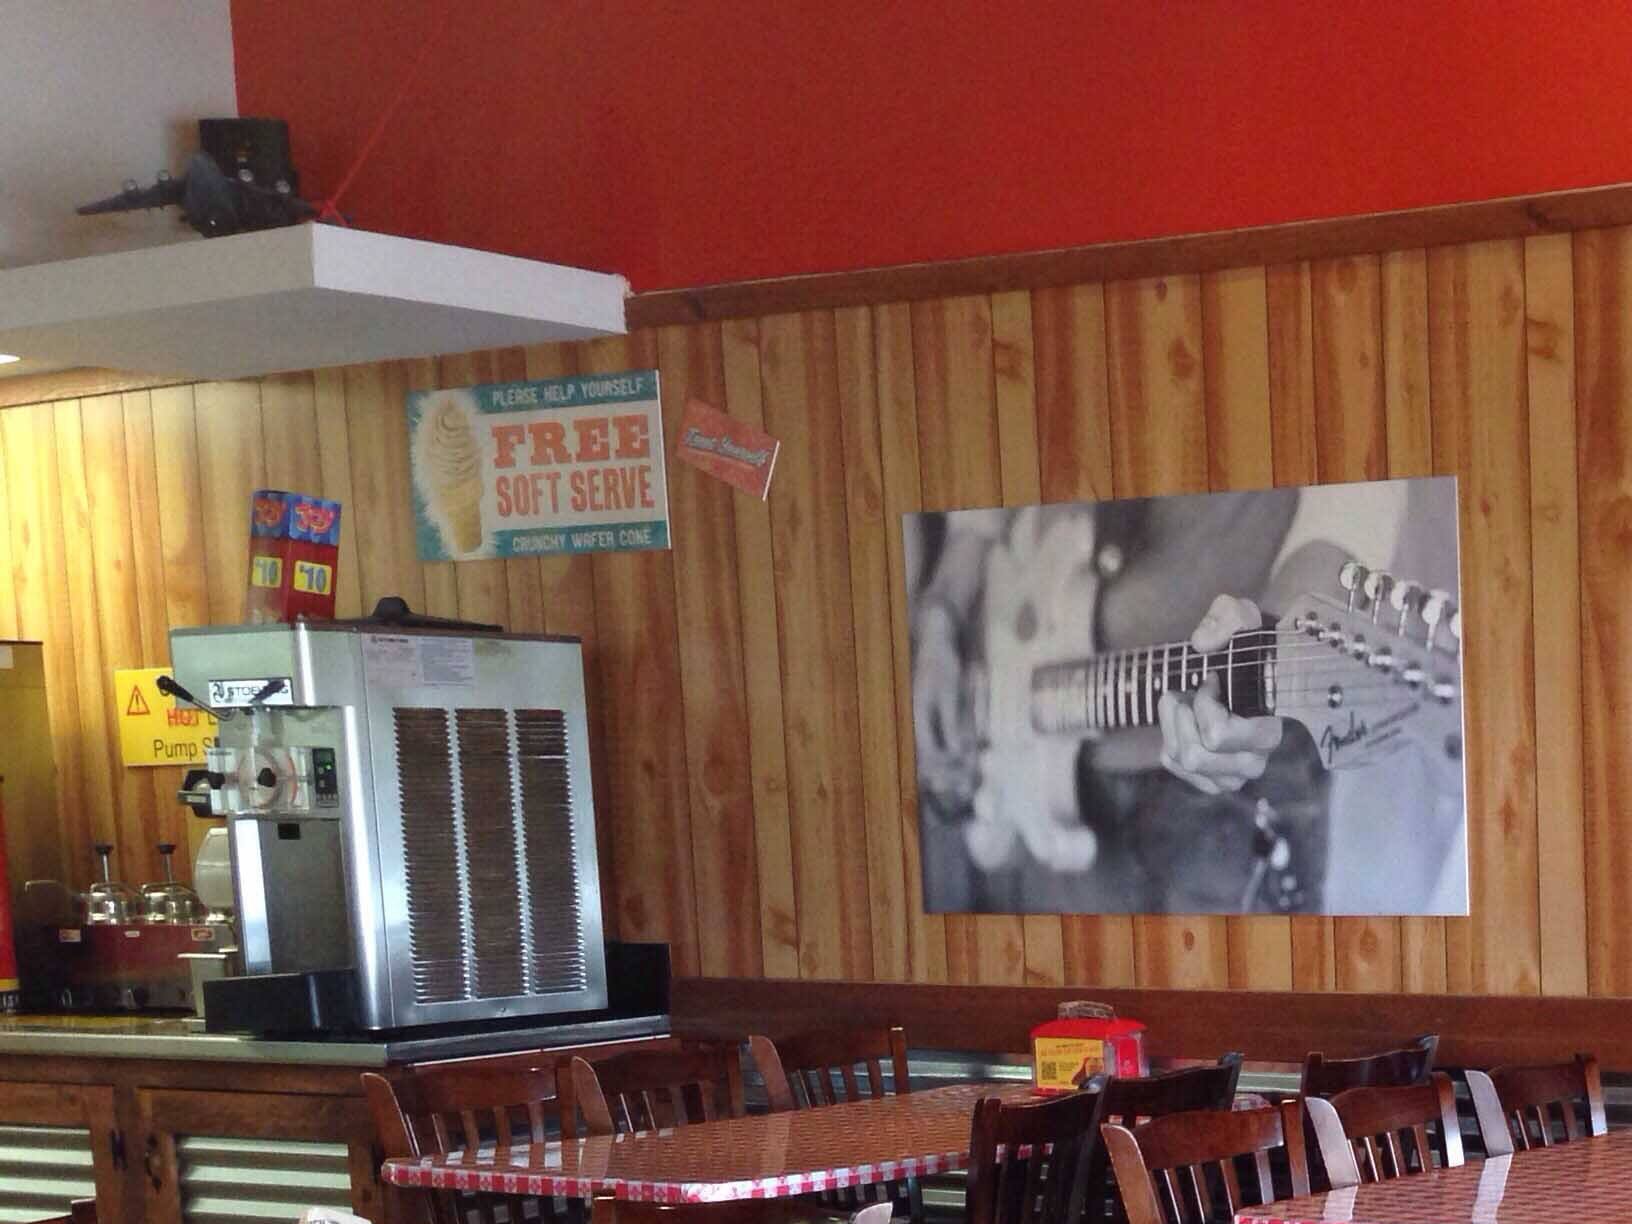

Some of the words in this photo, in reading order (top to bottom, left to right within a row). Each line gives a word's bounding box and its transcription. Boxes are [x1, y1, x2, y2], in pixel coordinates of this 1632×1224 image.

[492, 386, 538, 405] PLEASE
[544, 383, 577, 401] HELP
[582, 378, 644, 399] YOURSELF
[491, 414, 650, 469] FREE
[495, 471, 563, 518] SOFT
[570, 465, 656, 512] SERVE
[512, 533, 568, 551] CRUNCHY
[572, 531, 614, 547] WAFER
[620, 529, 652, 545] CONE
[153, 739, 198, 761] Pump
